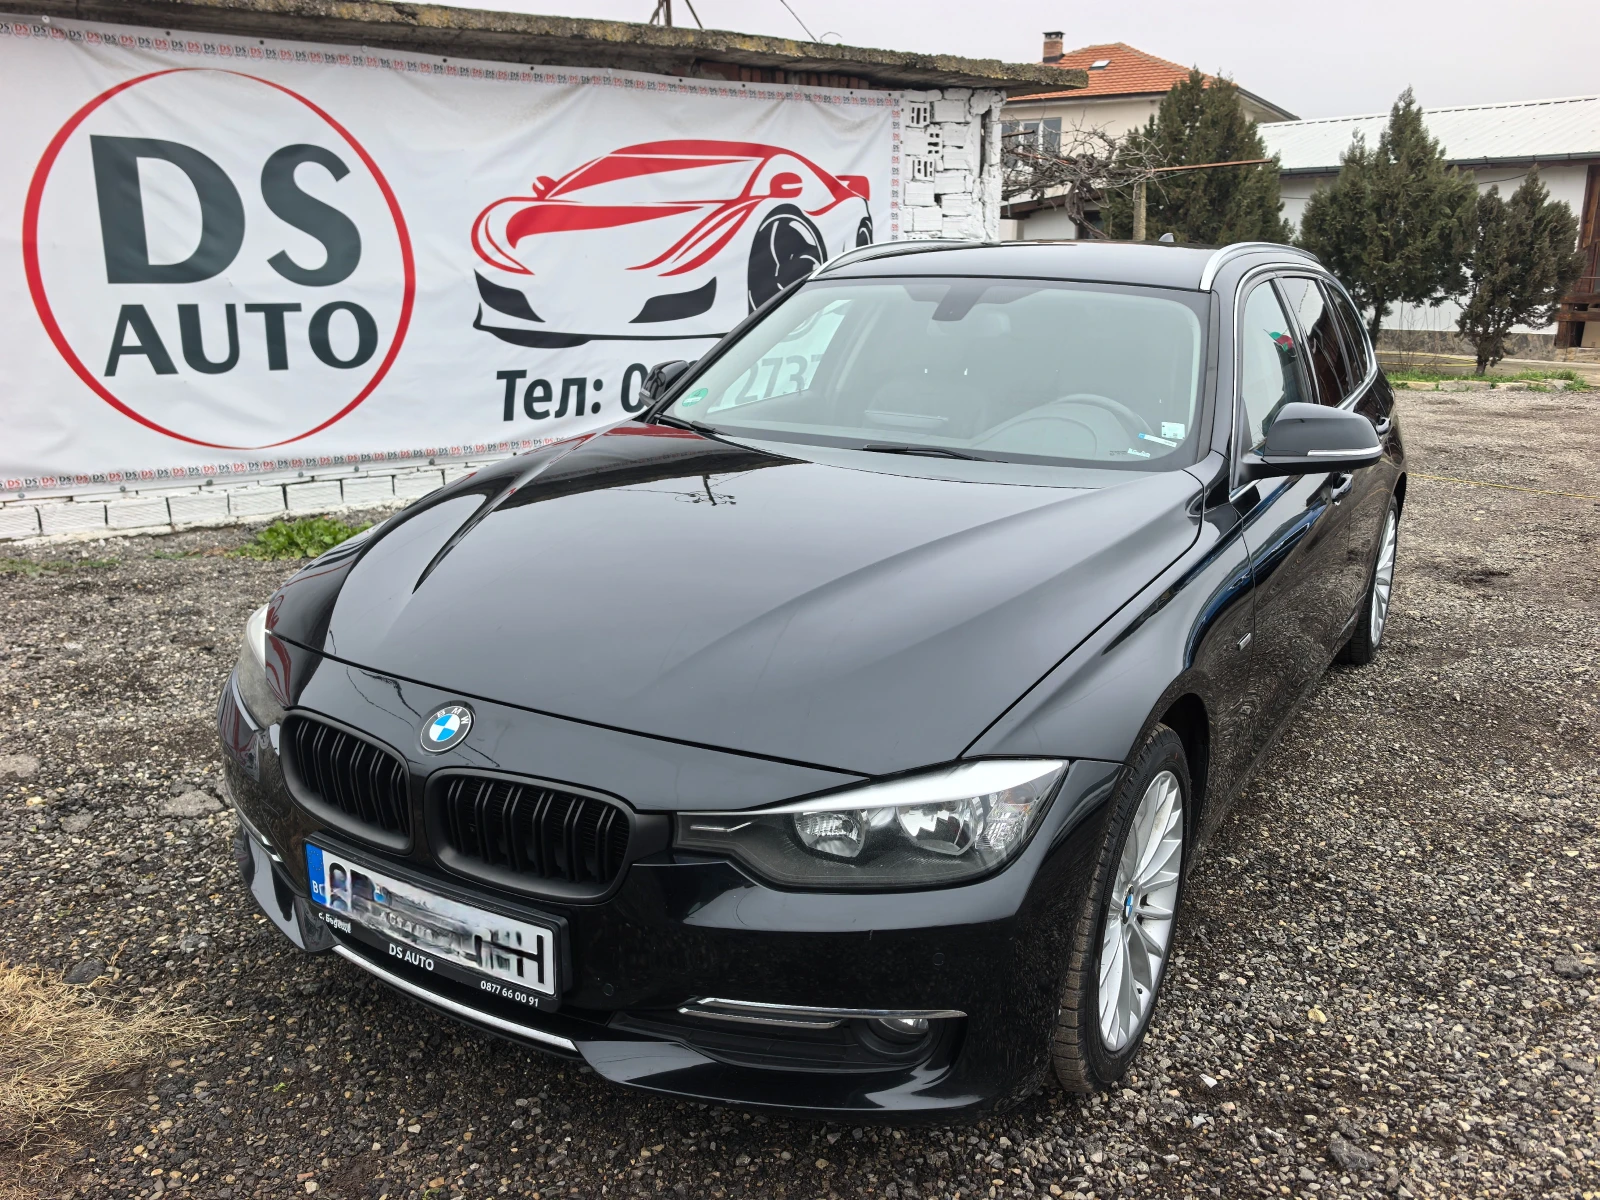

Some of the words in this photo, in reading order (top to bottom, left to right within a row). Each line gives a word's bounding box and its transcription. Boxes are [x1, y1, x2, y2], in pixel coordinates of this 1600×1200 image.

[90, 134, 362, 287] DS
[104, 300, 378, 377] AUTO
[496, 369, 604, 422] Тел:
[436, 706, 470, 725] BMW
[389, 943, 403, 959] DS
[404, 950, 434, 971] AUTO
[480, 980, 500, 995] 0877
[502, 988, 513, 999] 66
[514, 991, 527, 1003] 00
[528, 995, 539, 1008] 91
